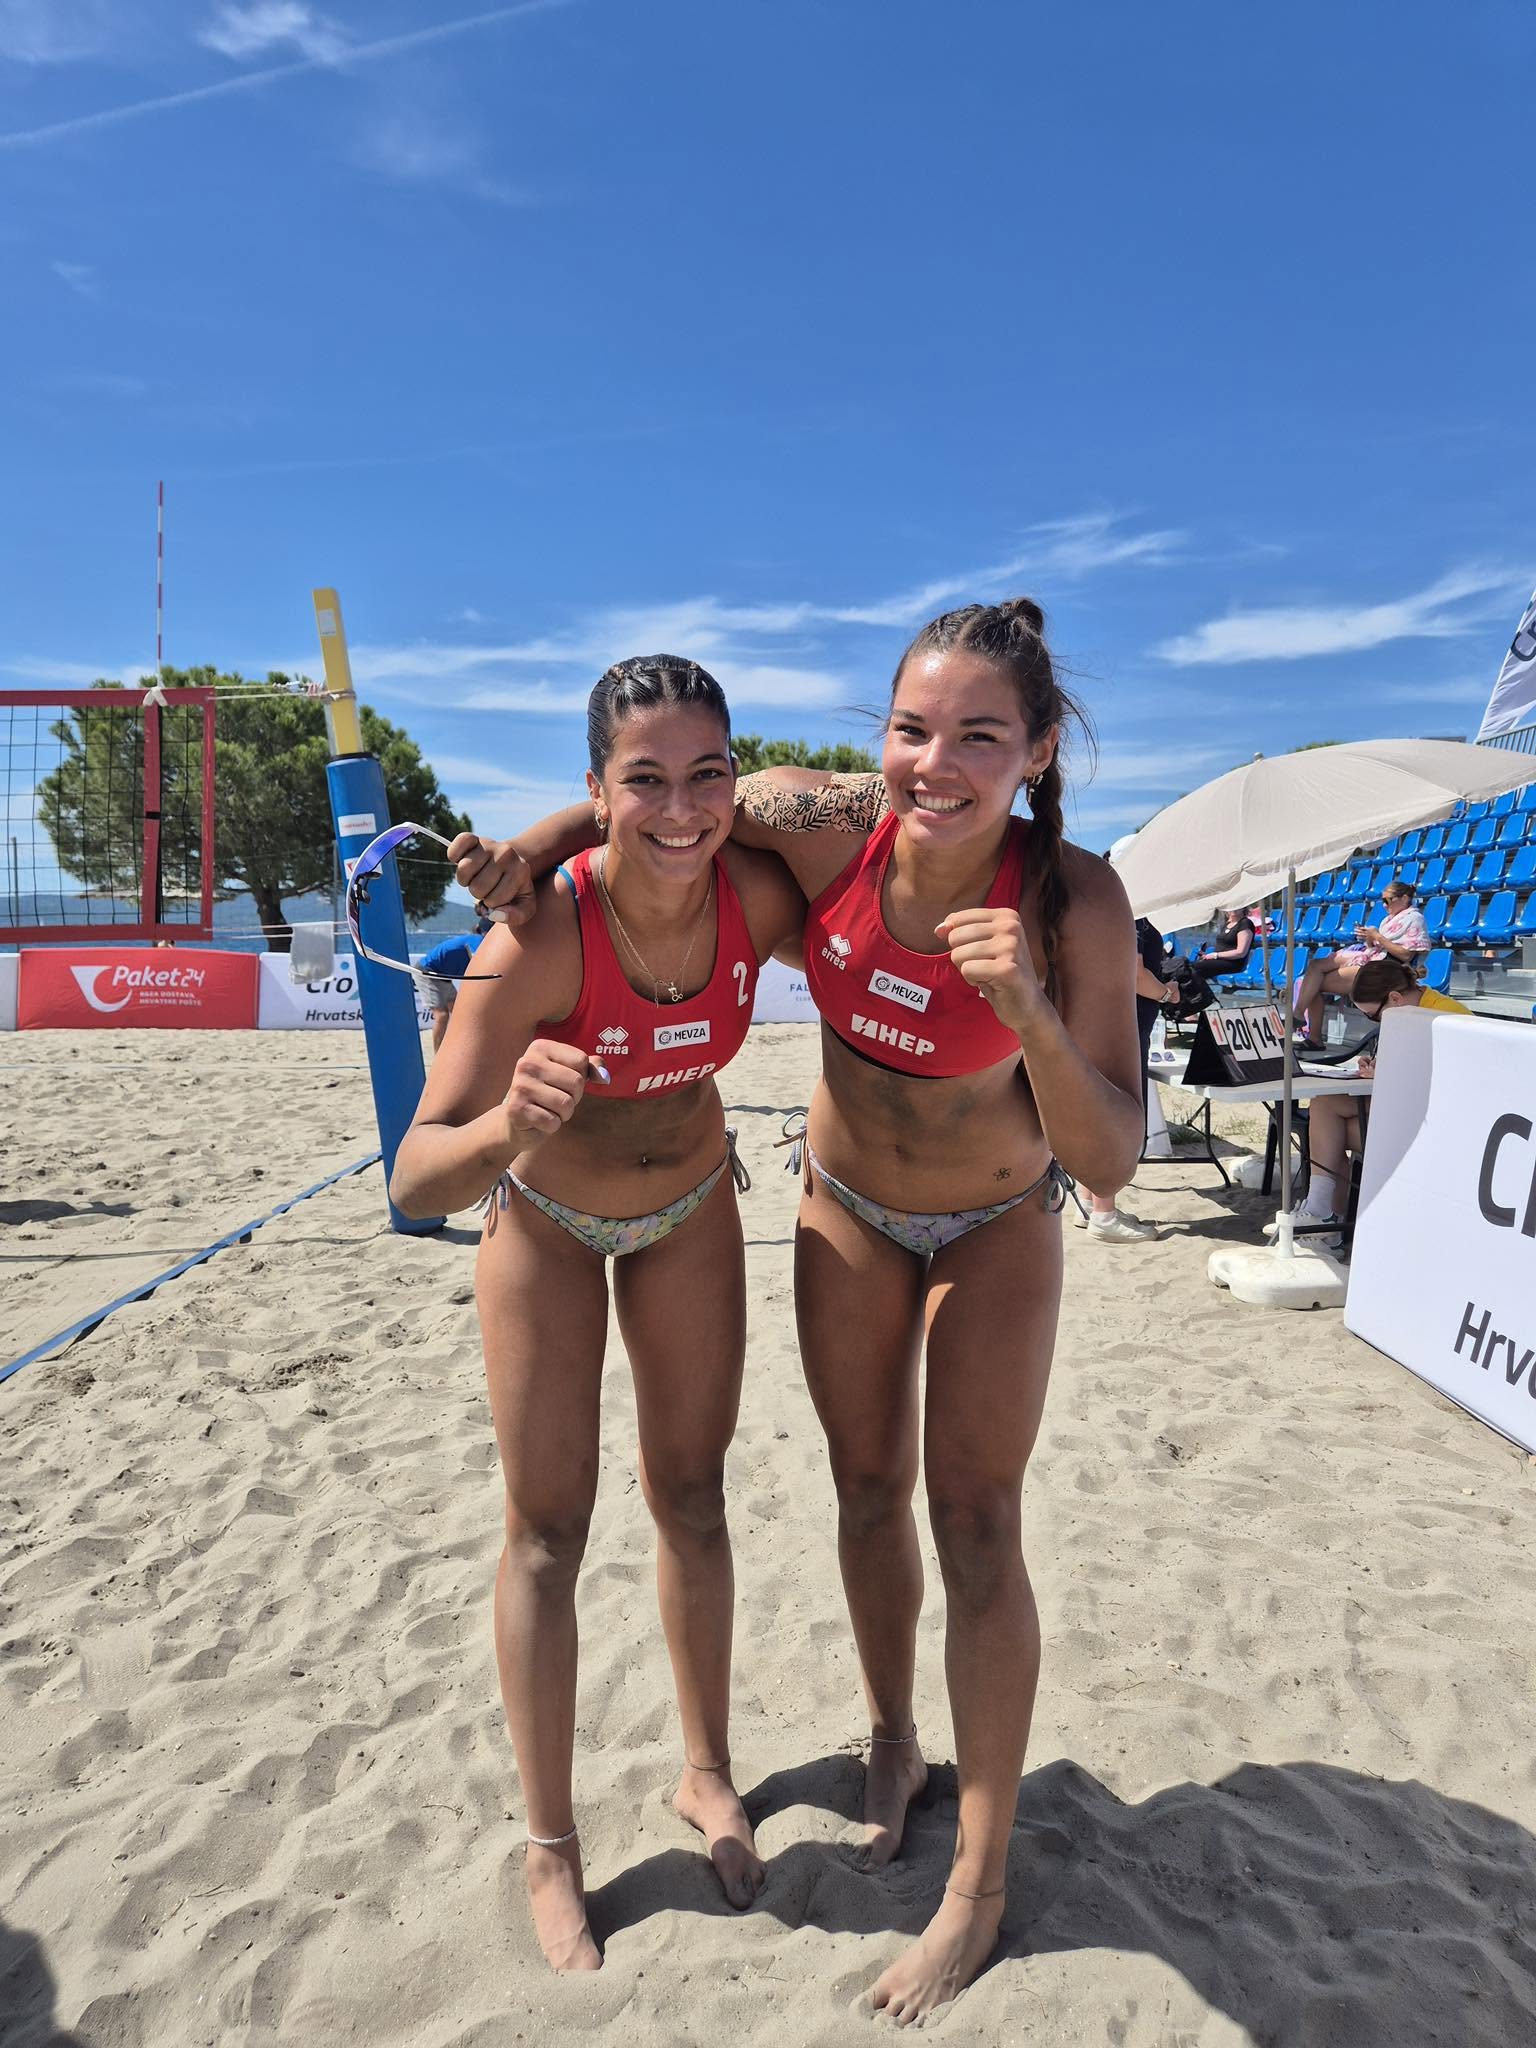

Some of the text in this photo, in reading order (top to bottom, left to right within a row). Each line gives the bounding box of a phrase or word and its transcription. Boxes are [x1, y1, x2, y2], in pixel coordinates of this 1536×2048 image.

[821, 947, 847, 971] errea
[732, 961, 749, 1007] 2
[790, 983, 809, 991] FAL
[891, 983, 924, 1005] MEVZA
[305, 1009, 364, 1021] Hrvatsk
[674, 1027, 706, 1041] MEVZA
[1212, 1012, 1285, 1050] 1 20 14 0
[595, 1045, 629, 1055] errea
